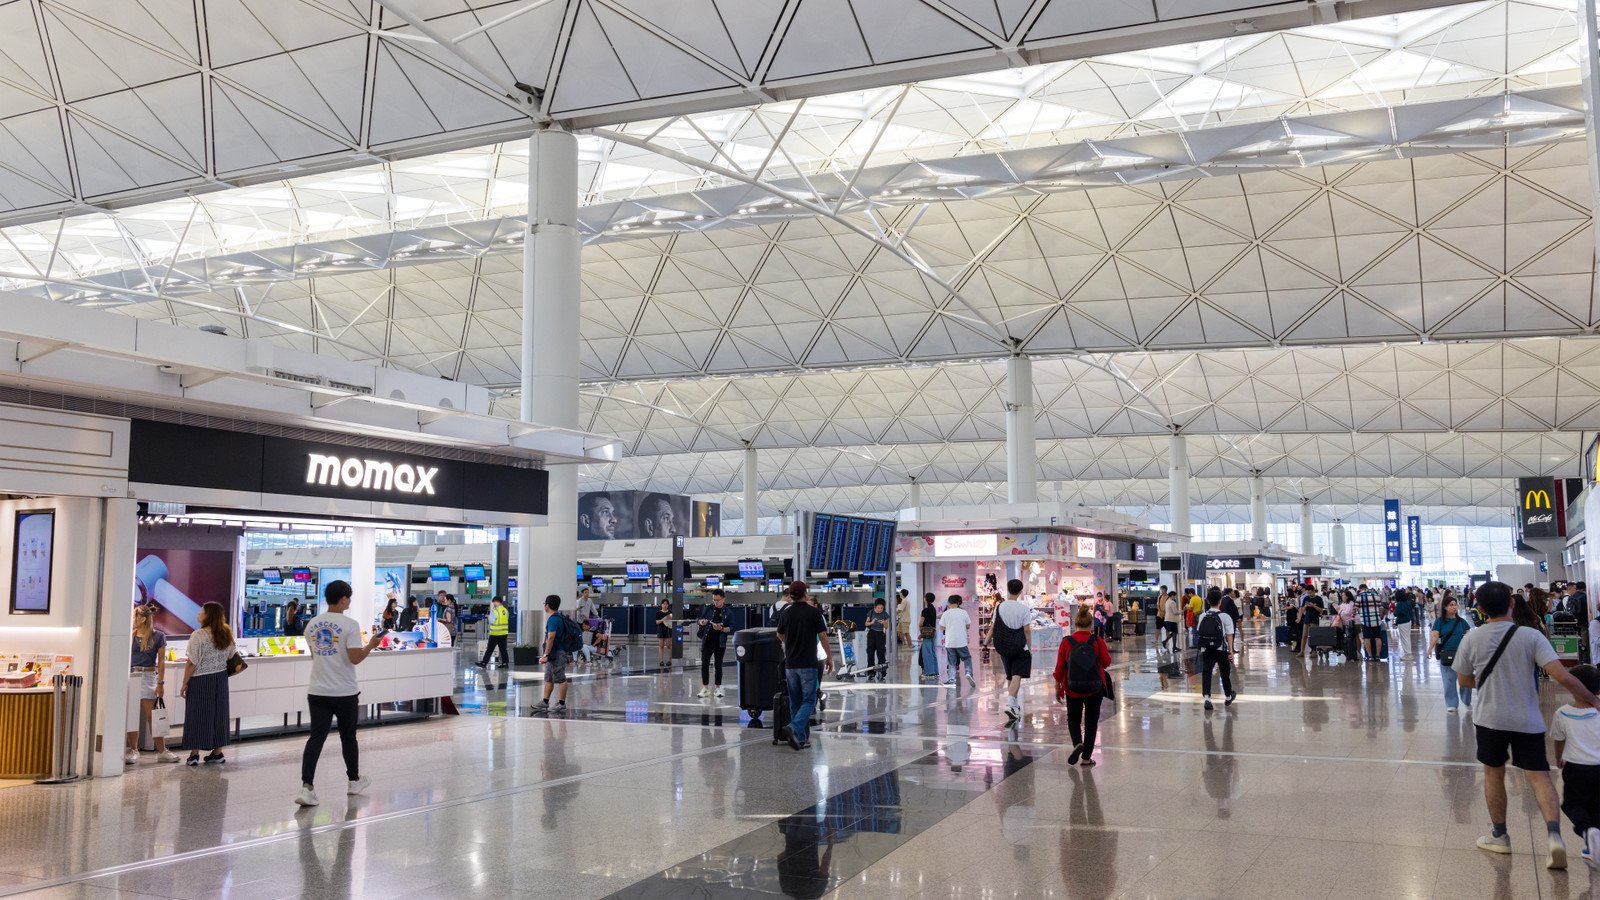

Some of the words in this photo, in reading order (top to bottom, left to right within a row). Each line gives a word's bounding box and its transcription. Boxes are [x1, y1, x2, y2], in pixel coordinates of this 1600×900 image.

[306, 453, 439, 495] momax
[1051, 516, 1057, 526] F
[1410, 519, 1418, 548] Departures
